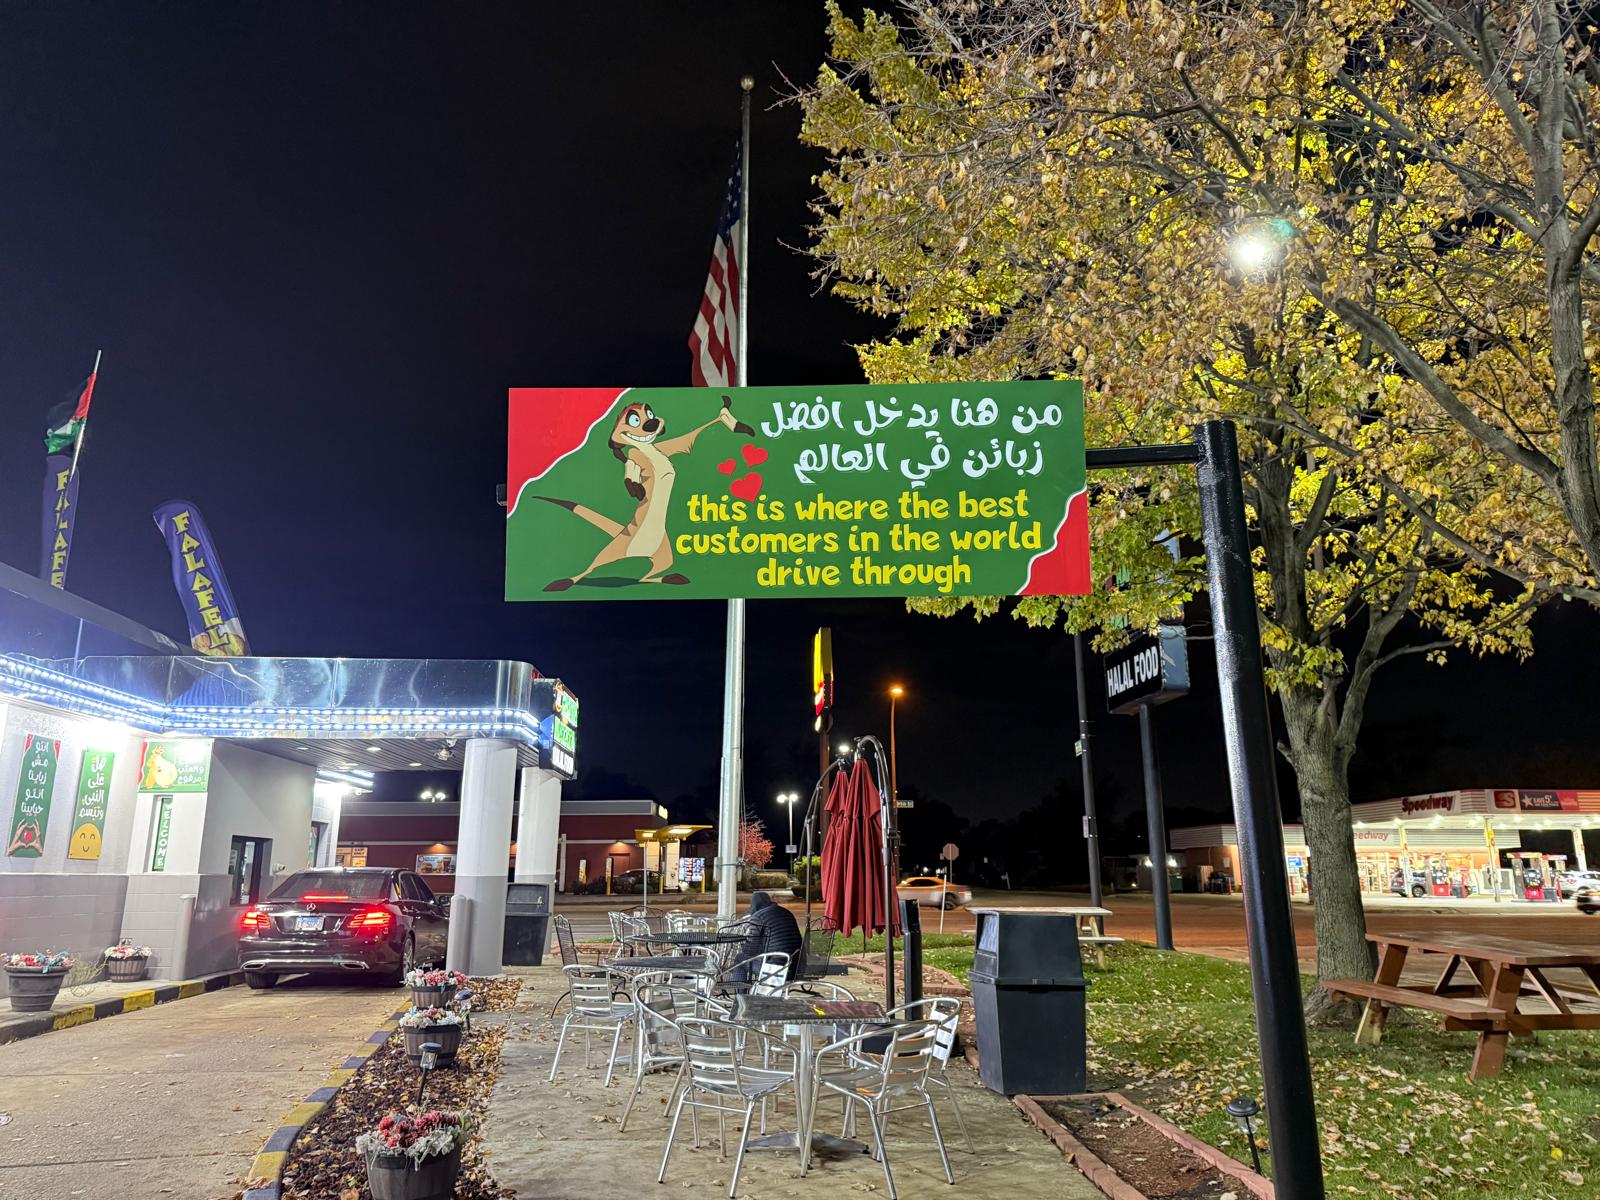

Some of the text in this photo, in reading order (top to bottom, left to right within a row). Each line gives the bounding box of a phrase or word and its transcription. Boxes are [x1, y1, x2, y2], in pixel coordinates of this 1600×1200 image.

[760, 396, 1062, 439] من هنا يدخل افضل
[793, 436, 1043, 489] زبائن في العالم
[687, 489, 1029, 522] this is where the best
[51, 469, 71, 590] FALAFE
[675, 521, 1042, 554] customers in the world
[172, 511, 230, 650] FALAFEL
[756, 555, 971, 593] drive through
[1107, 645, 1159, 698] HALAL FOOD
[1401, 795, 1454, 815] Speedway
[157, 803, 173, 867] WELCOME
[1353, 831, 1389, 842] eedway
